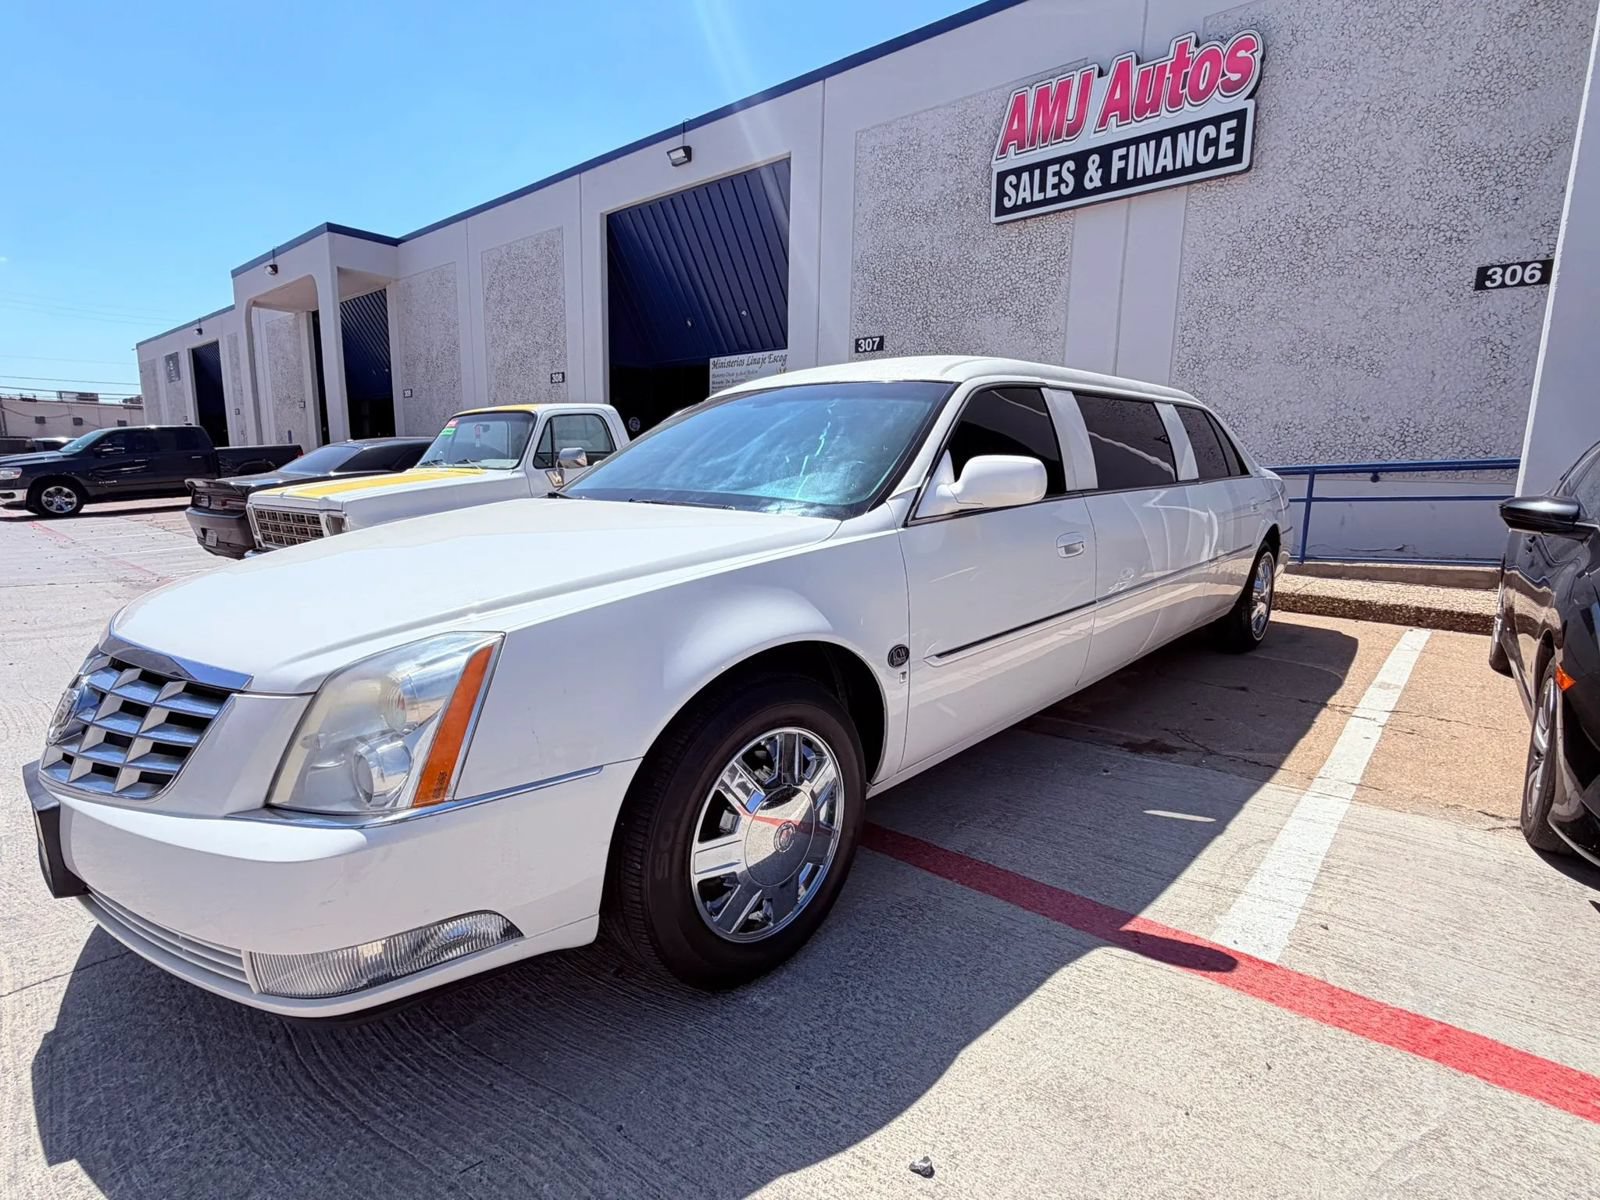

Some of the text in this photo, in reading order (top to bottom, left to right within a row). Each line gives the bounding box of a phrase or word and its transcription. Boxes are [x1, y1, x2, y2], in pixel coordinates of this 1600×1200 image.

[997, 34, 1260, 158] AMJ Autos
[1002, 118, 1239, 209] SALES & FINANCE
[1484, 262, 1543, 288] 306
[857, 337, 880, 352] 307
[711, 357, 745, 370] Ministerios
[746, 354, 767, 369] Linaje
